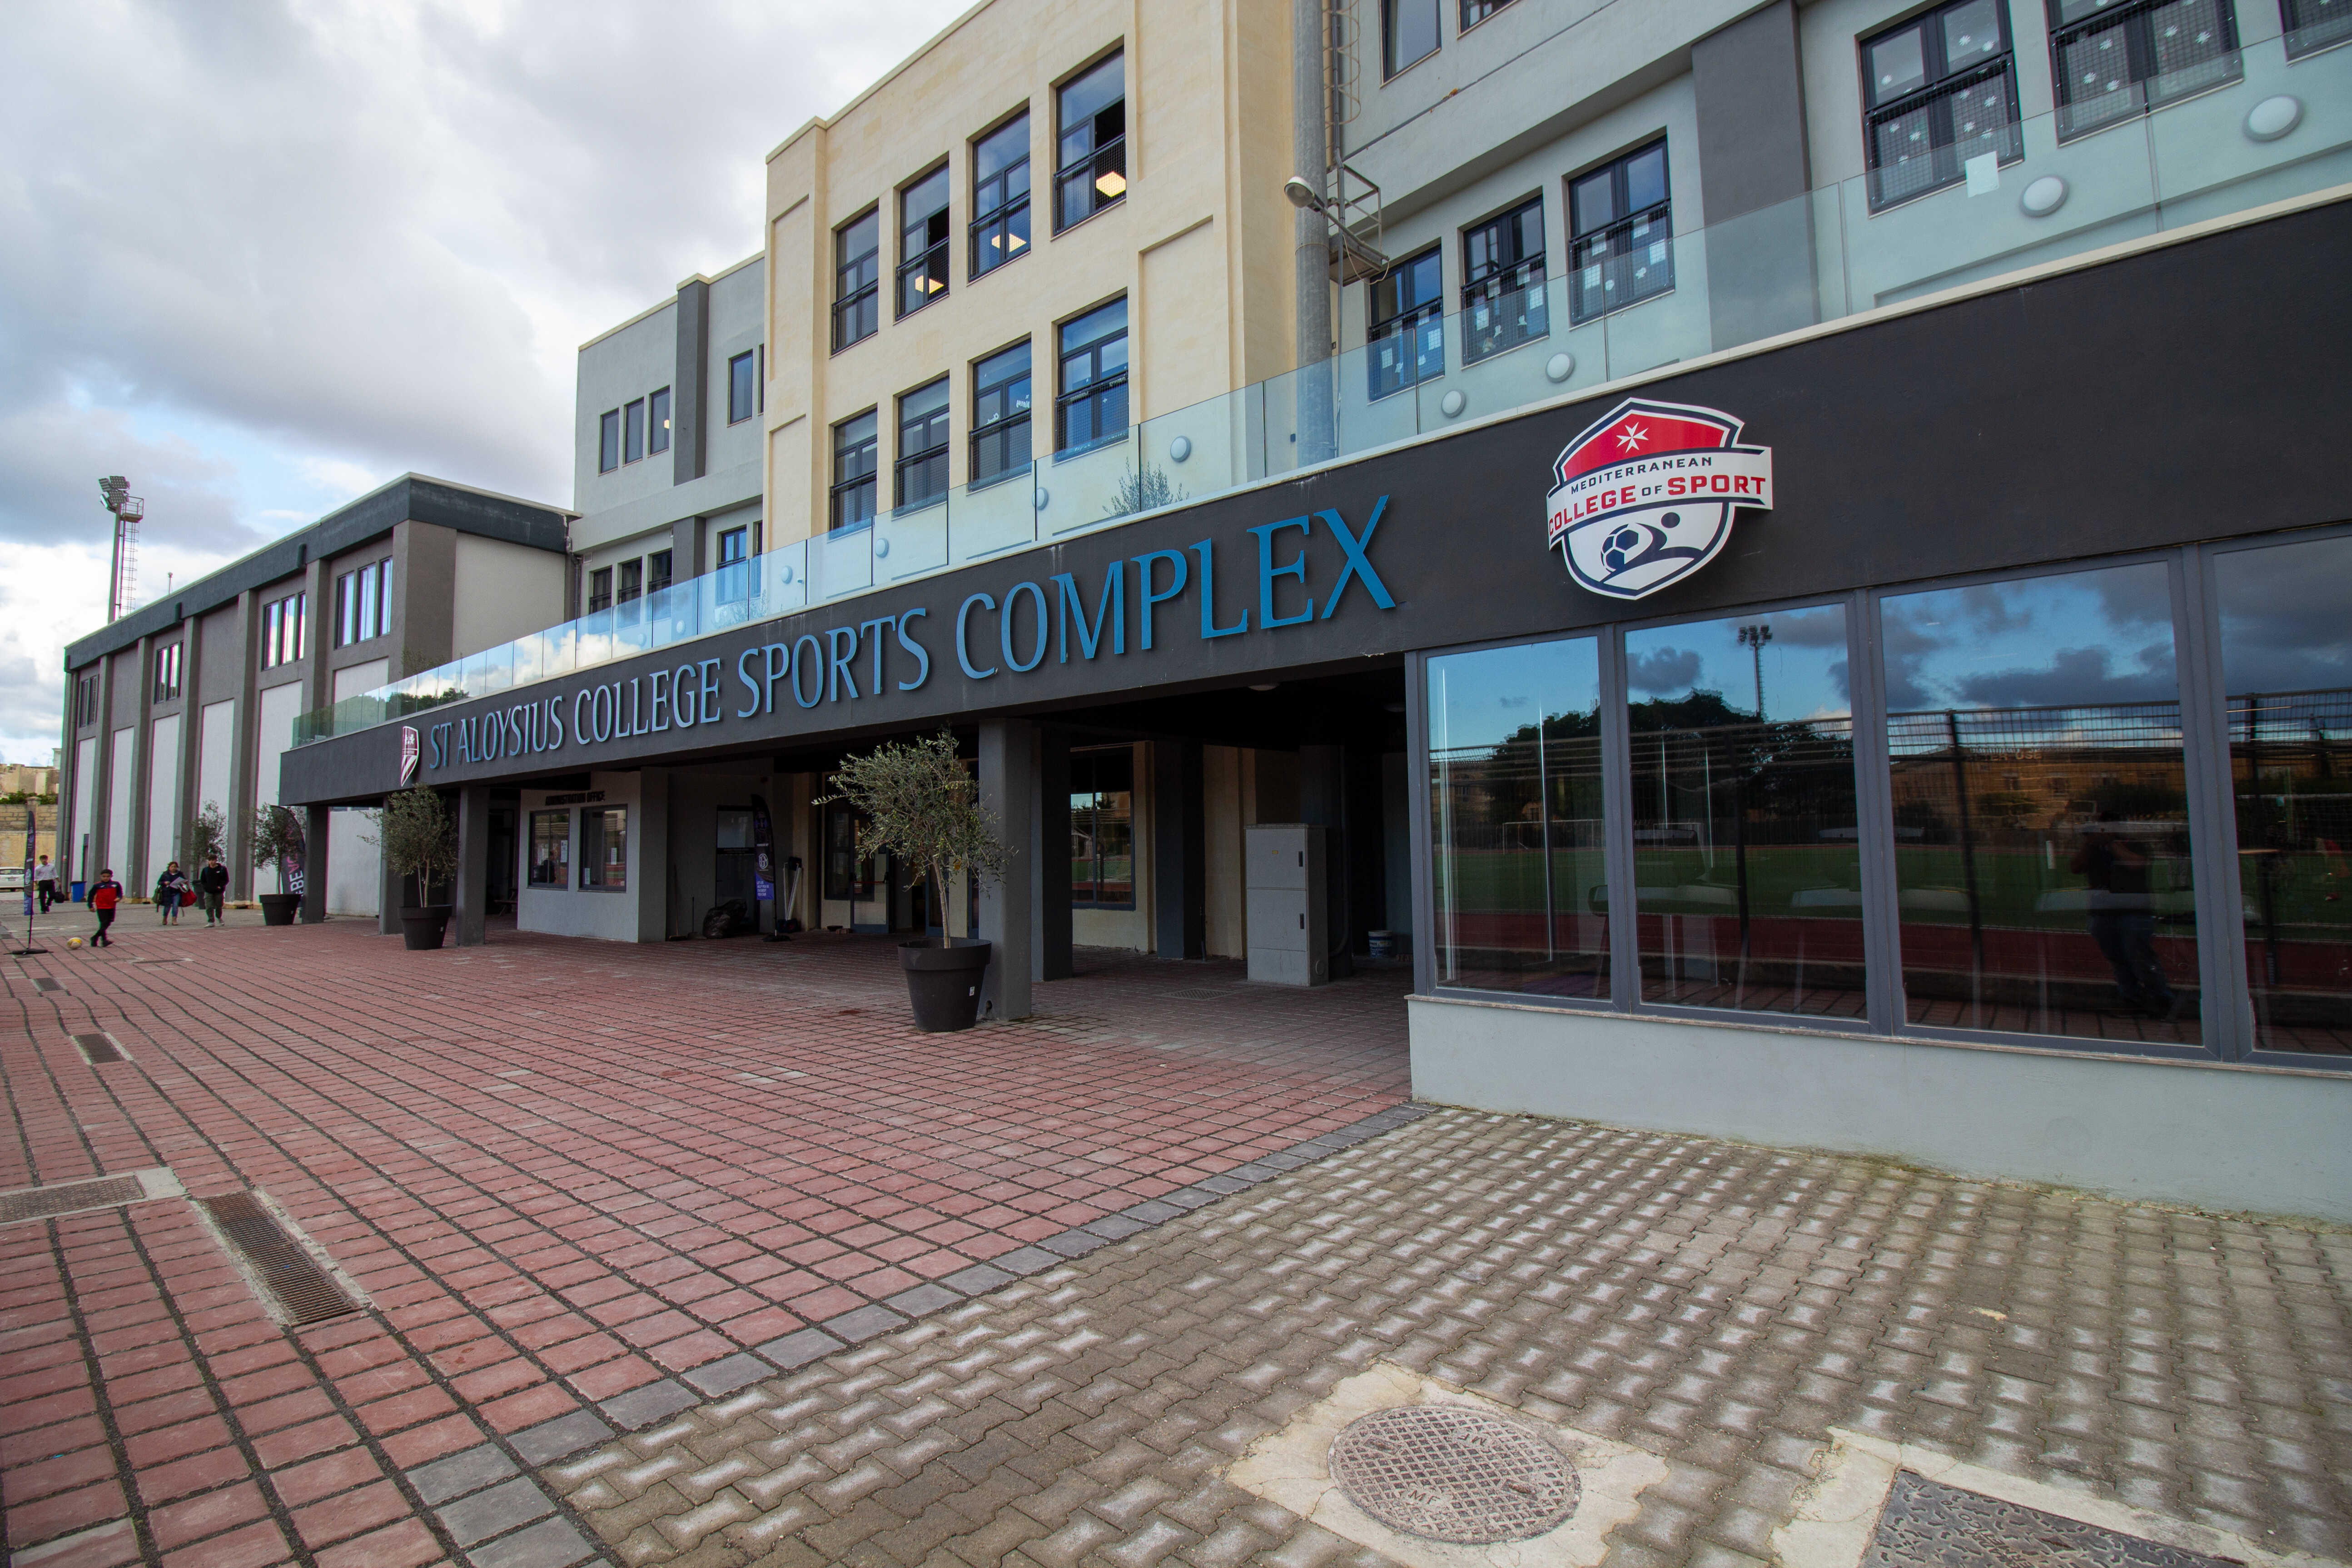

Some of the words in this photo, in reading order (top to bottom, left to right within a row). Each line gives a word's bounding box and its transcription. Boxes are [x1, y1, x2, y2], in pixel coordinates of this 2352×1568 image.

[1571, 457, 1712, 494] MEDITERRANEAN
[1548, 485, 1636, 536] COLLEGE
[1641, 484, 1663, 497] OF
[1667, 474, 1766, 496] SPORT
[430, 722, 452, 770] ST
[457, 695, 563, 765] ALOYSIUS
[574, 657, 721, 746] COLLEGE
[737, 607, 929, 718] SPORTS
[955, 494, 1397, 680] COMPLEX
[1408, 1490, 1441, 1504] MF
